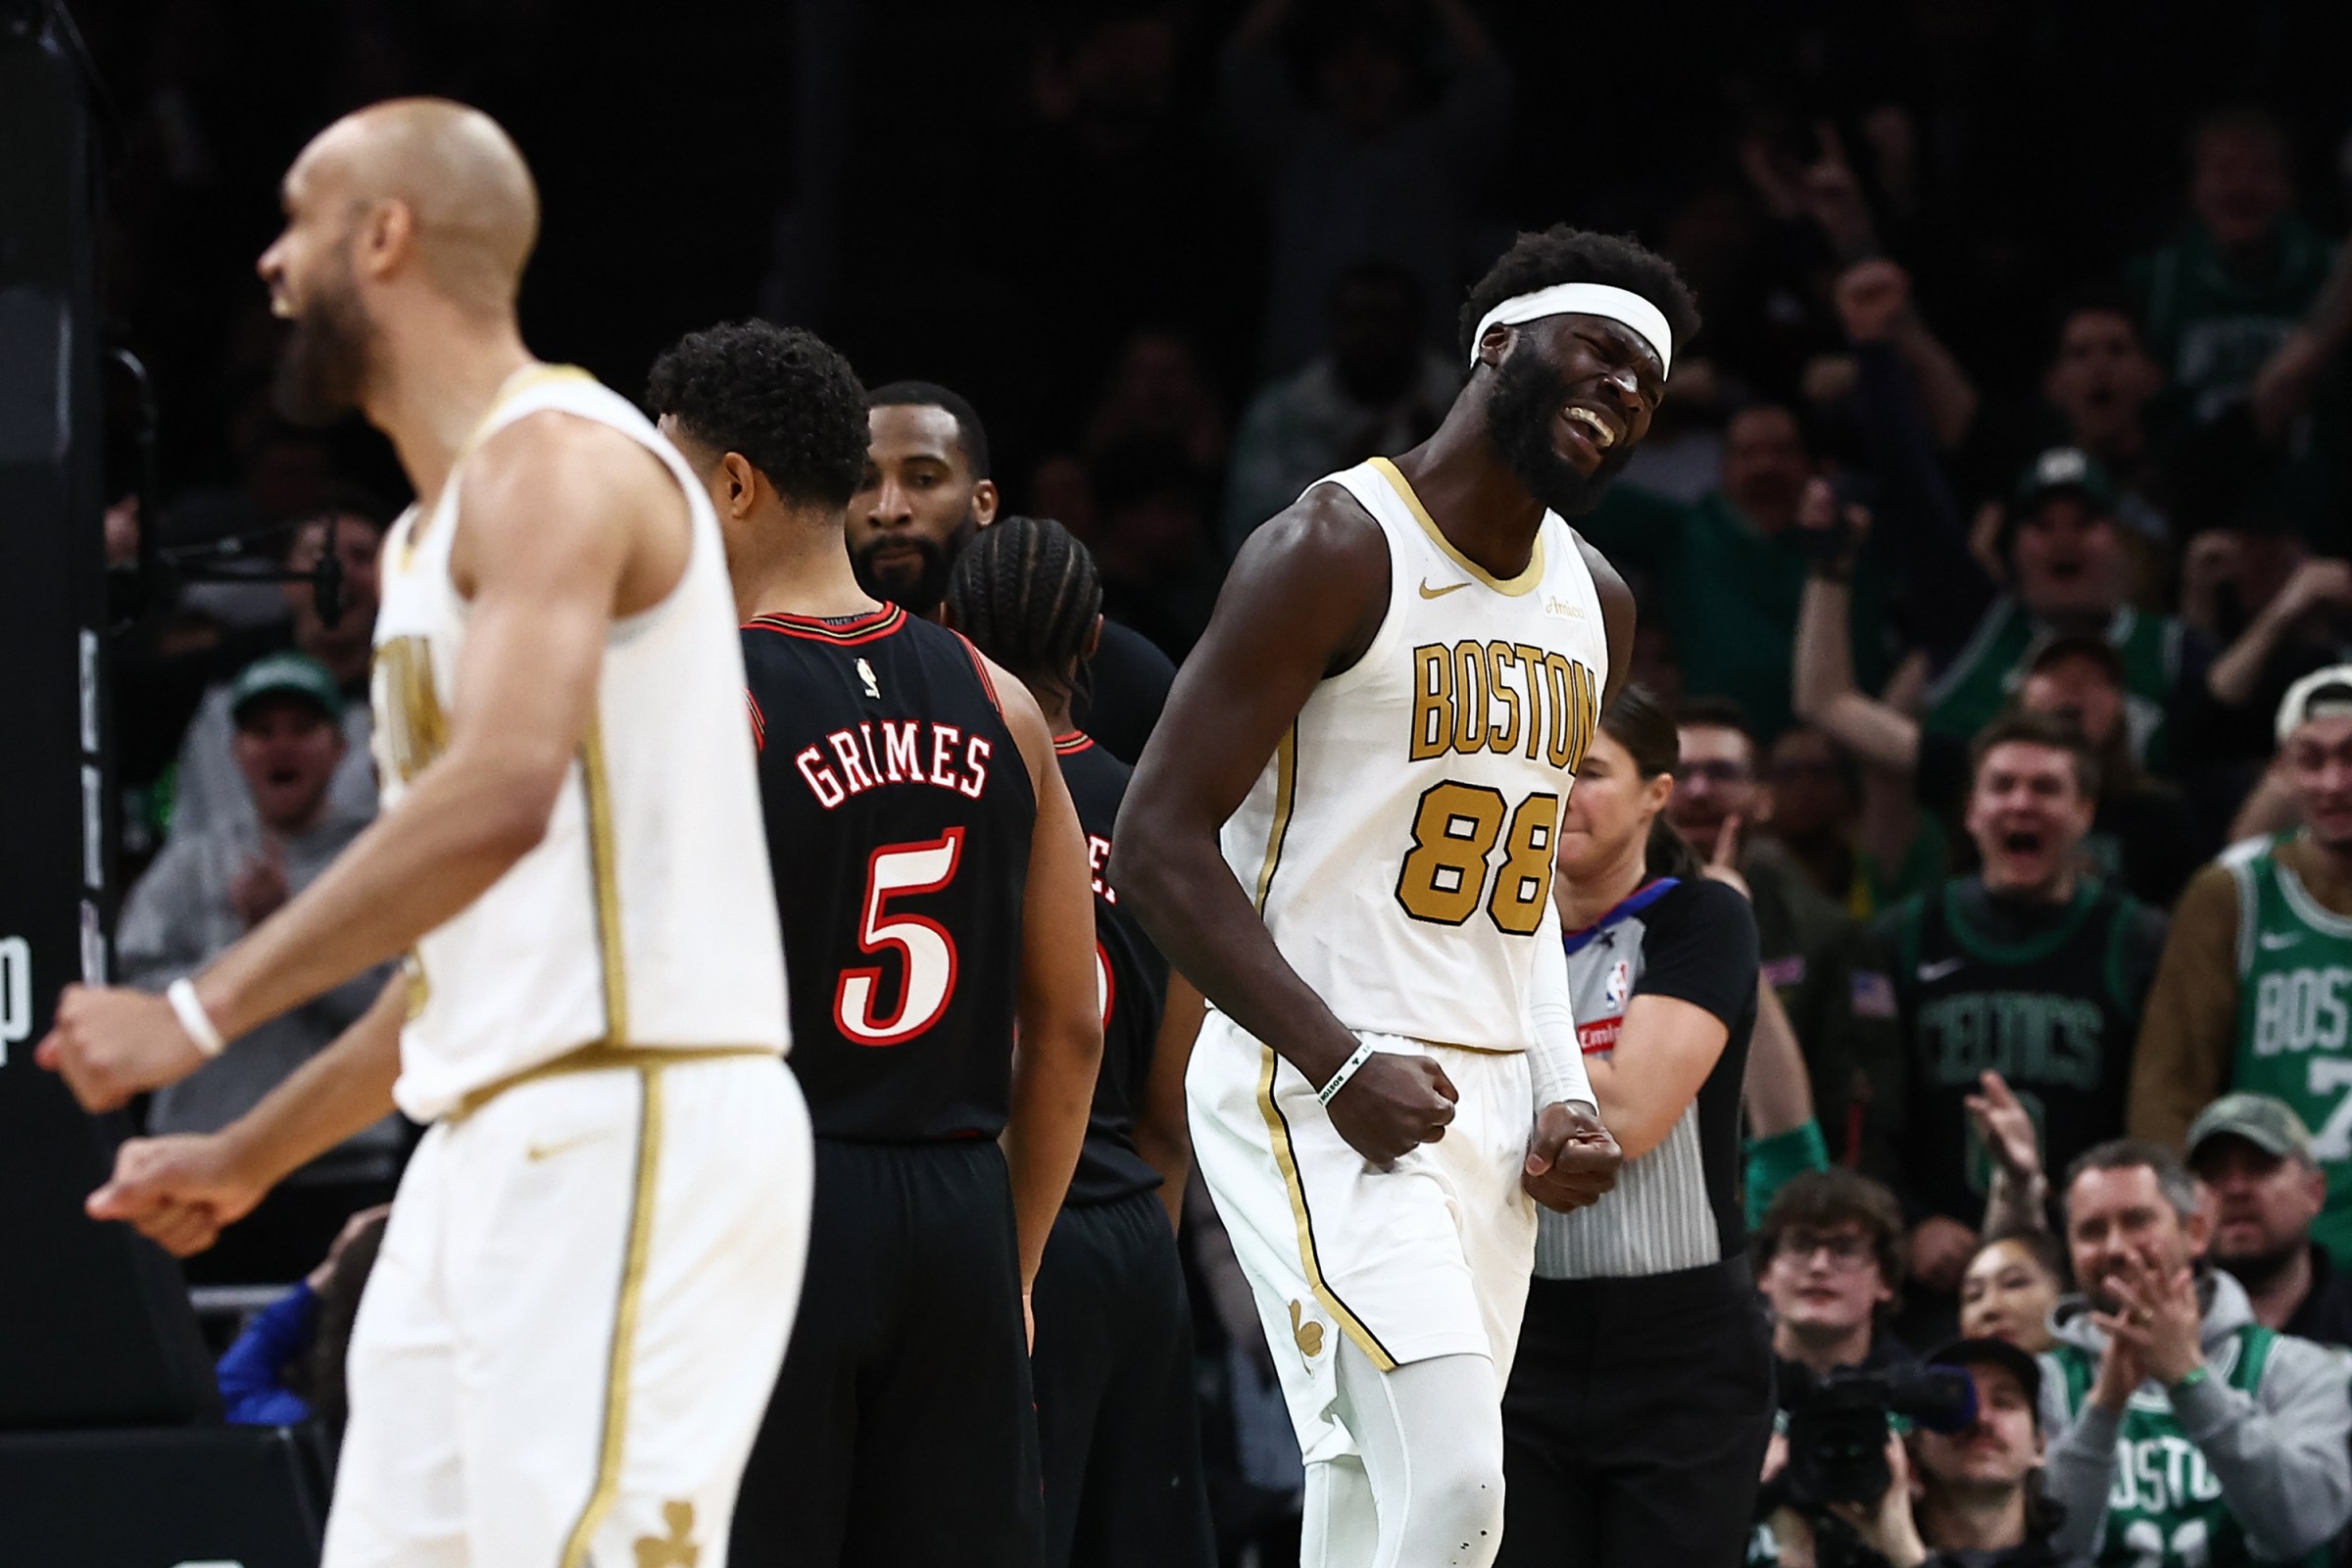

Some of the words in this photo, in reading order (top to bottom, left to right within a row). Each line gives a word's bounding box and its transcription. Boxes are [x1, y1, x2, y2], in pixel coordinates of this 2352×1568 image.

[794, 719, 994, 811] GRIMES
[1409, 639, 1597, 778] BOSTON
[1395, 778, 1559, 937] 88
[833, 825, 966, 1047] 5
[2253, 965, 2352, 1057] BOS
[1320, 1075, 1344, 1102] BOSTON
